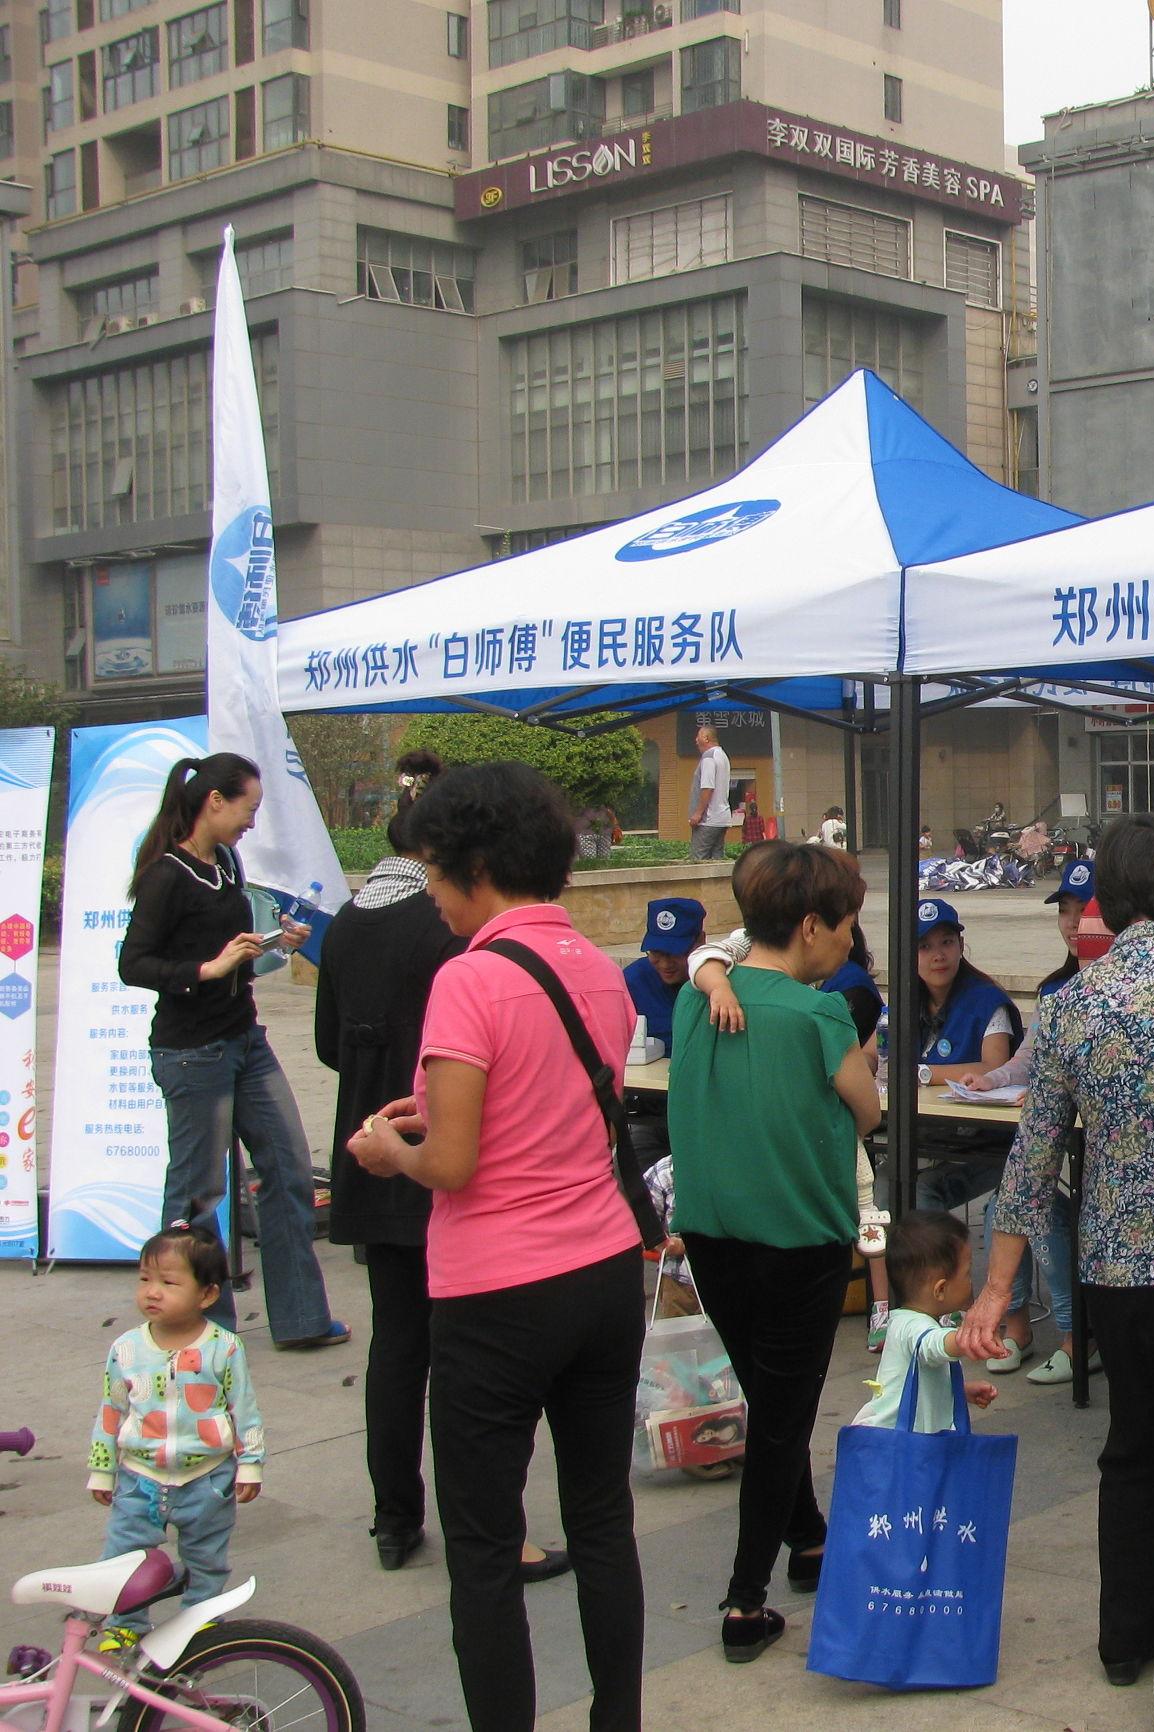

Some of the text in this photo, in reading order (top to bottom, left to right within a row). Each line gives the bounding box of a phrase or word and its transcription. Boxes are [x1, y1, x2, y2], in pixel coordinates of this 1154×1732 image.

[112, 1004, 148, 1015] 供水服务
[109, 1099, 167, 1109] 材料由用户自
[106, 1146, 160, 1156] 67680000
[867, 1601, 963, 1616] 67680000
